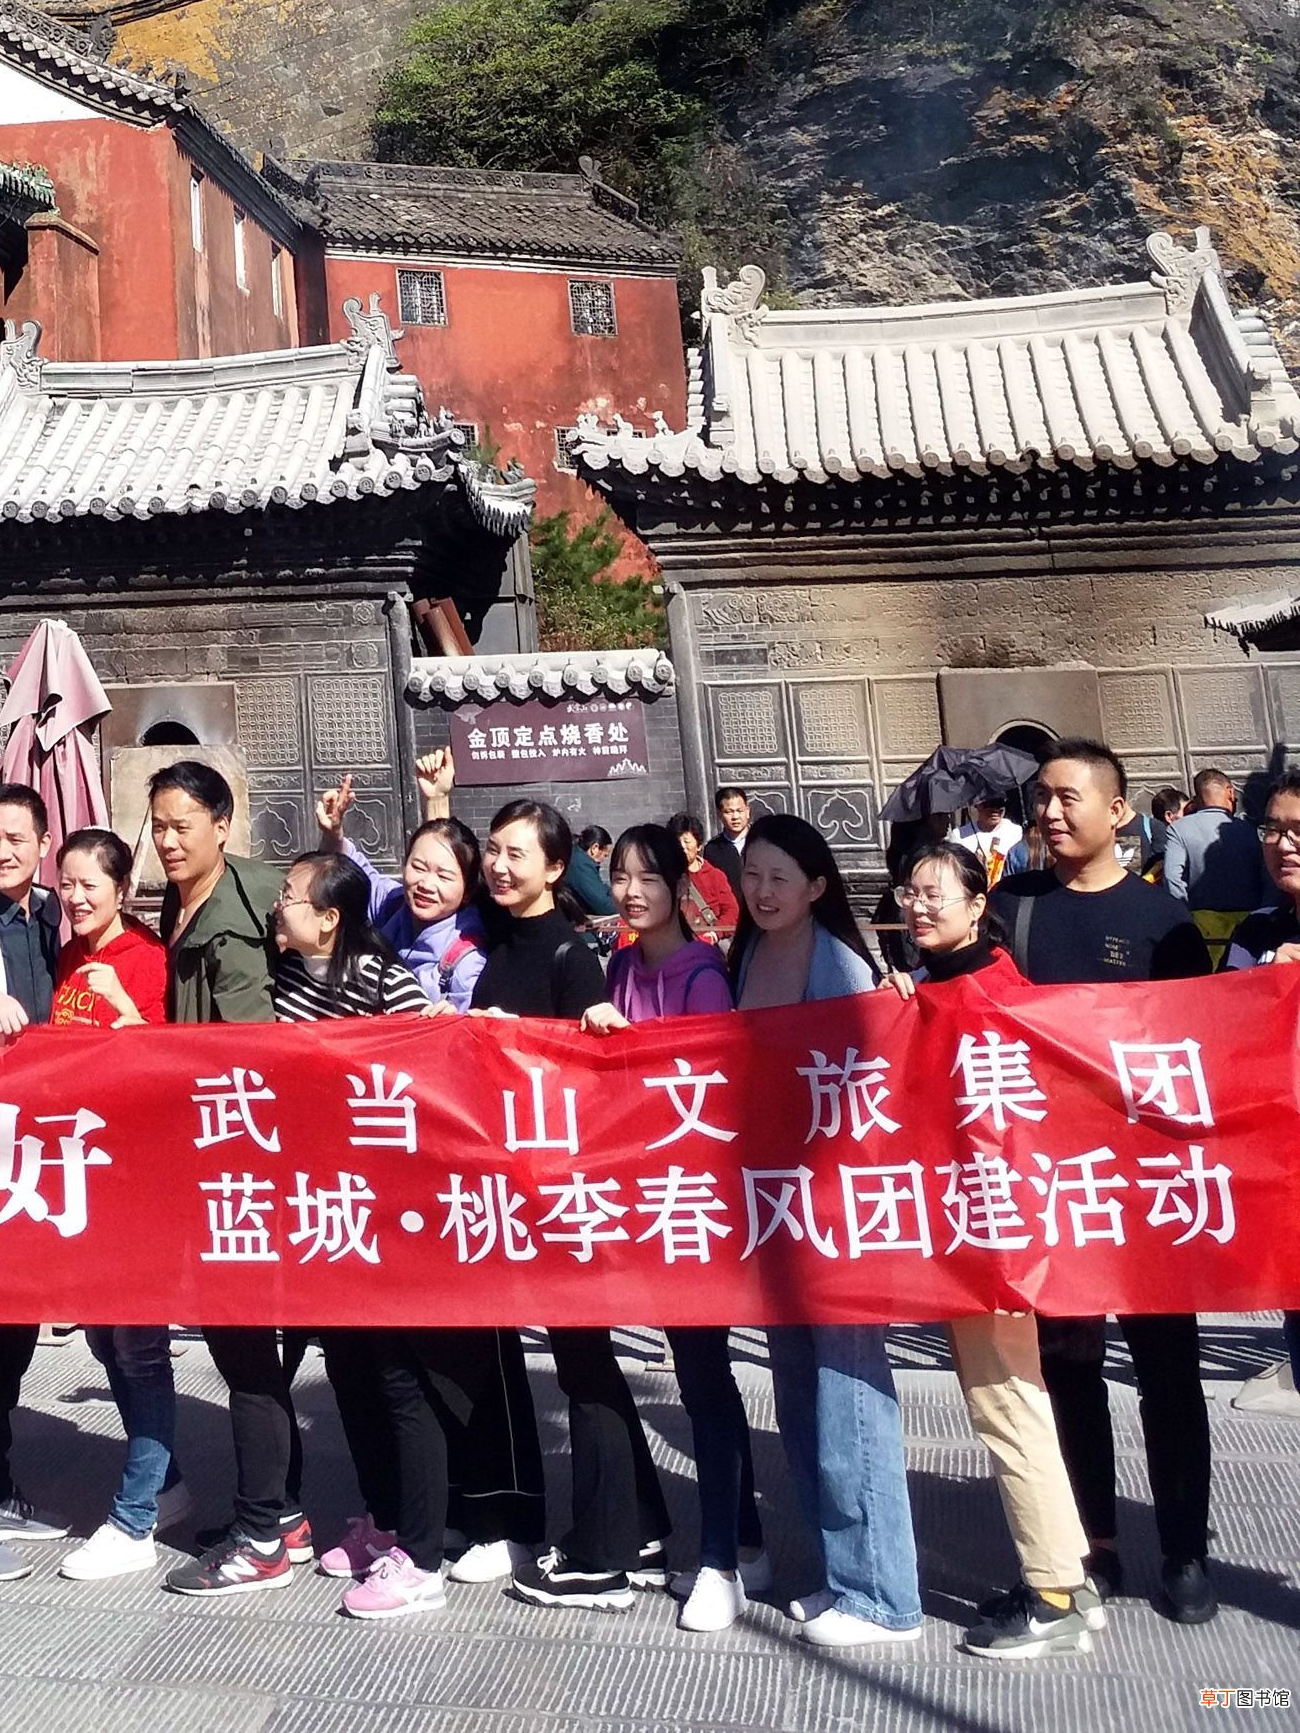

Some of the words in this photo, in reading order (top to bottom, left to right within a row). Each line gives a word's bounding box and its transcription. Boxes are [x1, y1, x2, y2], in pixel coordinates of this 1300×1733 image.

[466, 722, 630, 749] 金顶定点烧香处
[551, 746, 587, 757] 炉内有火
[190, 1031, 1216, 1155] 武当山文旅集团
[198, 1144, 1236, 1265] 蓝城·桃李春风团建活动
